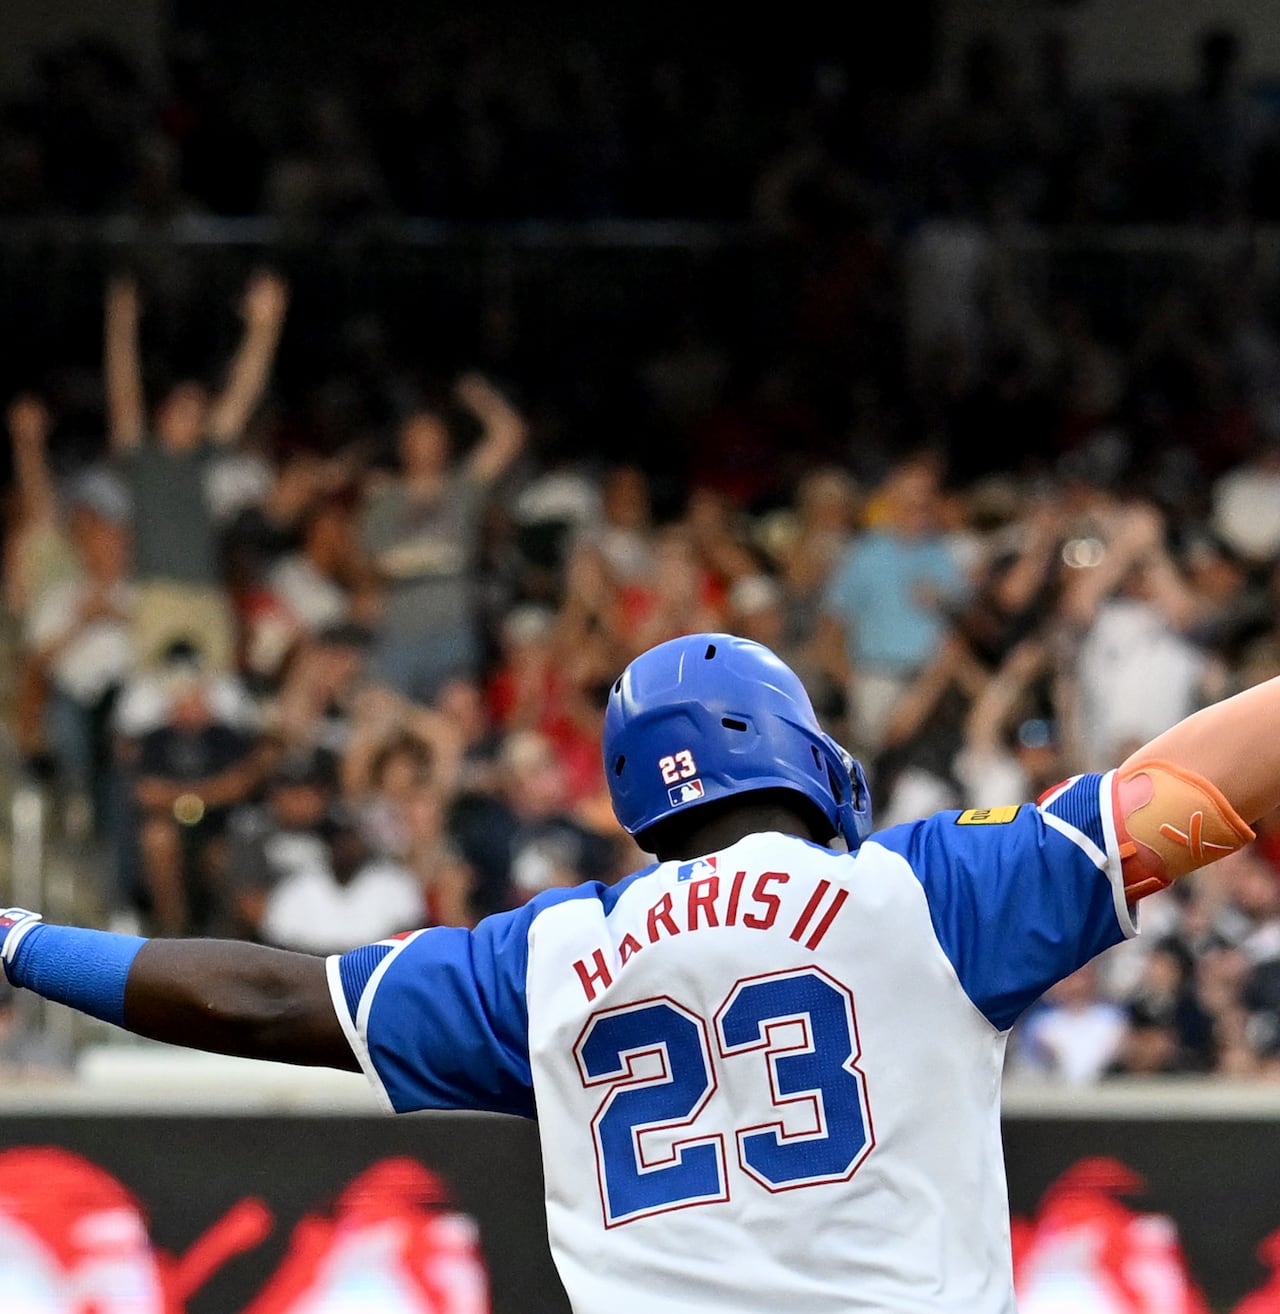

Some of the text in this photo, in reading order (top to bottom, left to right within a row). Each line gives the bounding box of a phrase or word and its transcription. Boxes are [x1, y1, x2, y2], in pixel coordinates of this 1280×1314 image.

[658, 749, 697, 785] 23
[572, 871, 849, 1002] HARRIS II
[572, 964, 876, 1231] 23
